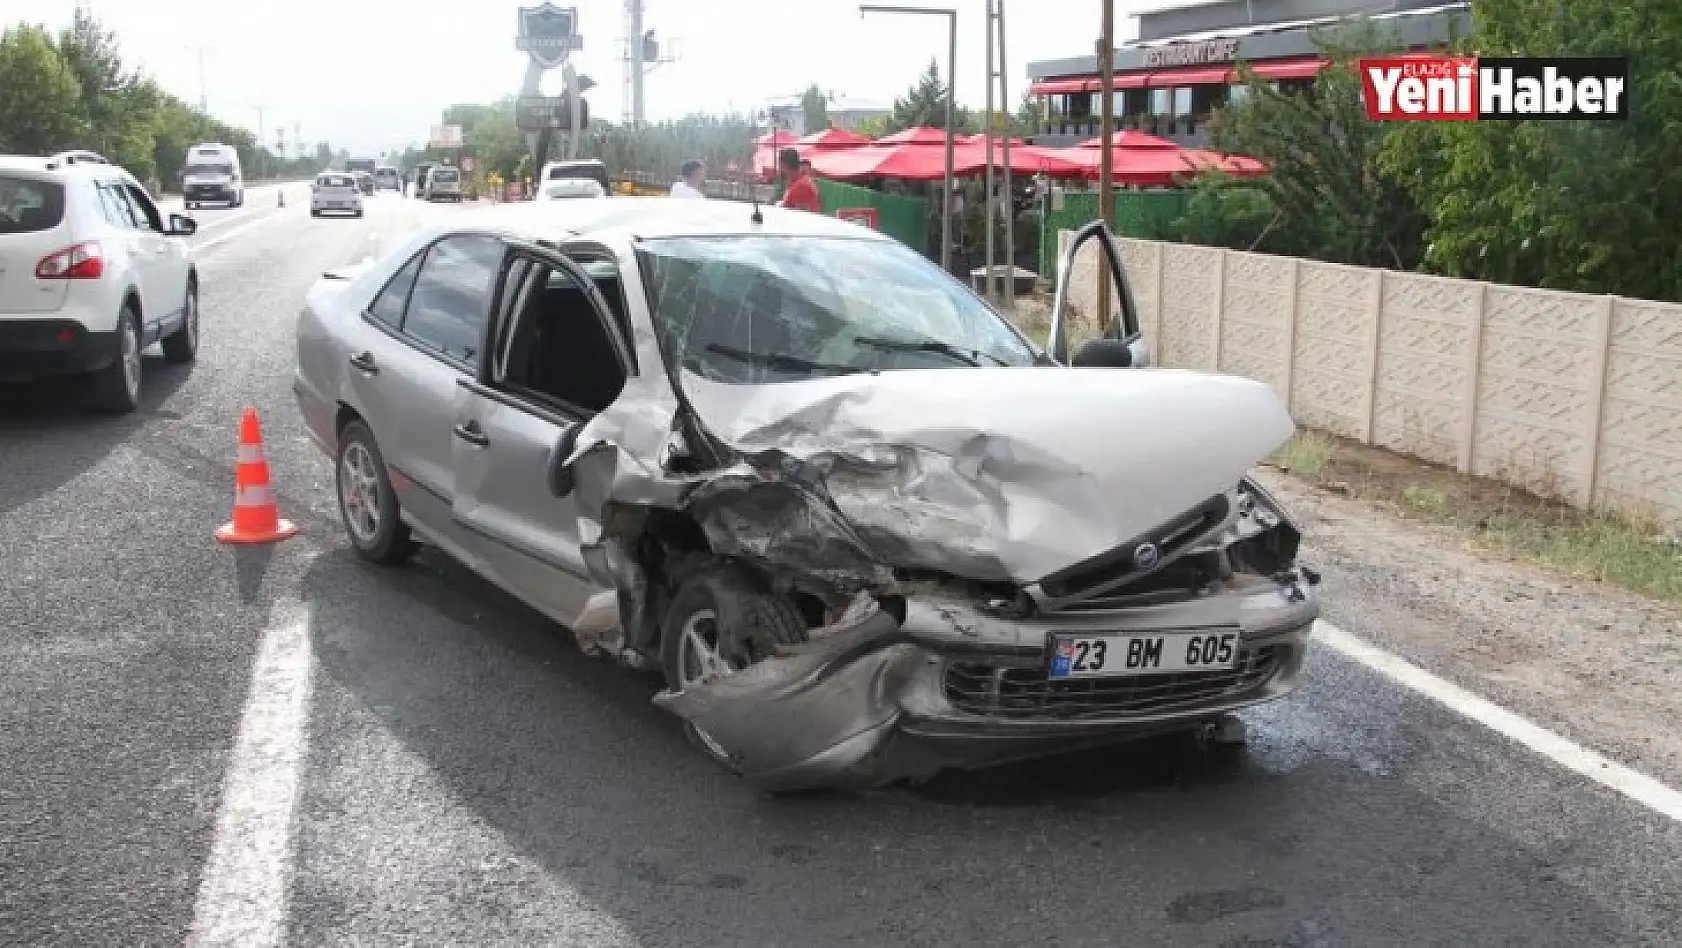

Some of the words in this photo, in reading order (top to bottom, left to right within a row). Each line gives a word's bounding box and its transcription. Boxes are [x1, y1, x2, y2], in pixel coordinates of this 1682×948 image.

[1072, 640, 1107, 671] 23
[1126, 637, 1164, 668] BM
[1186, 633, 1236, 664] 605
